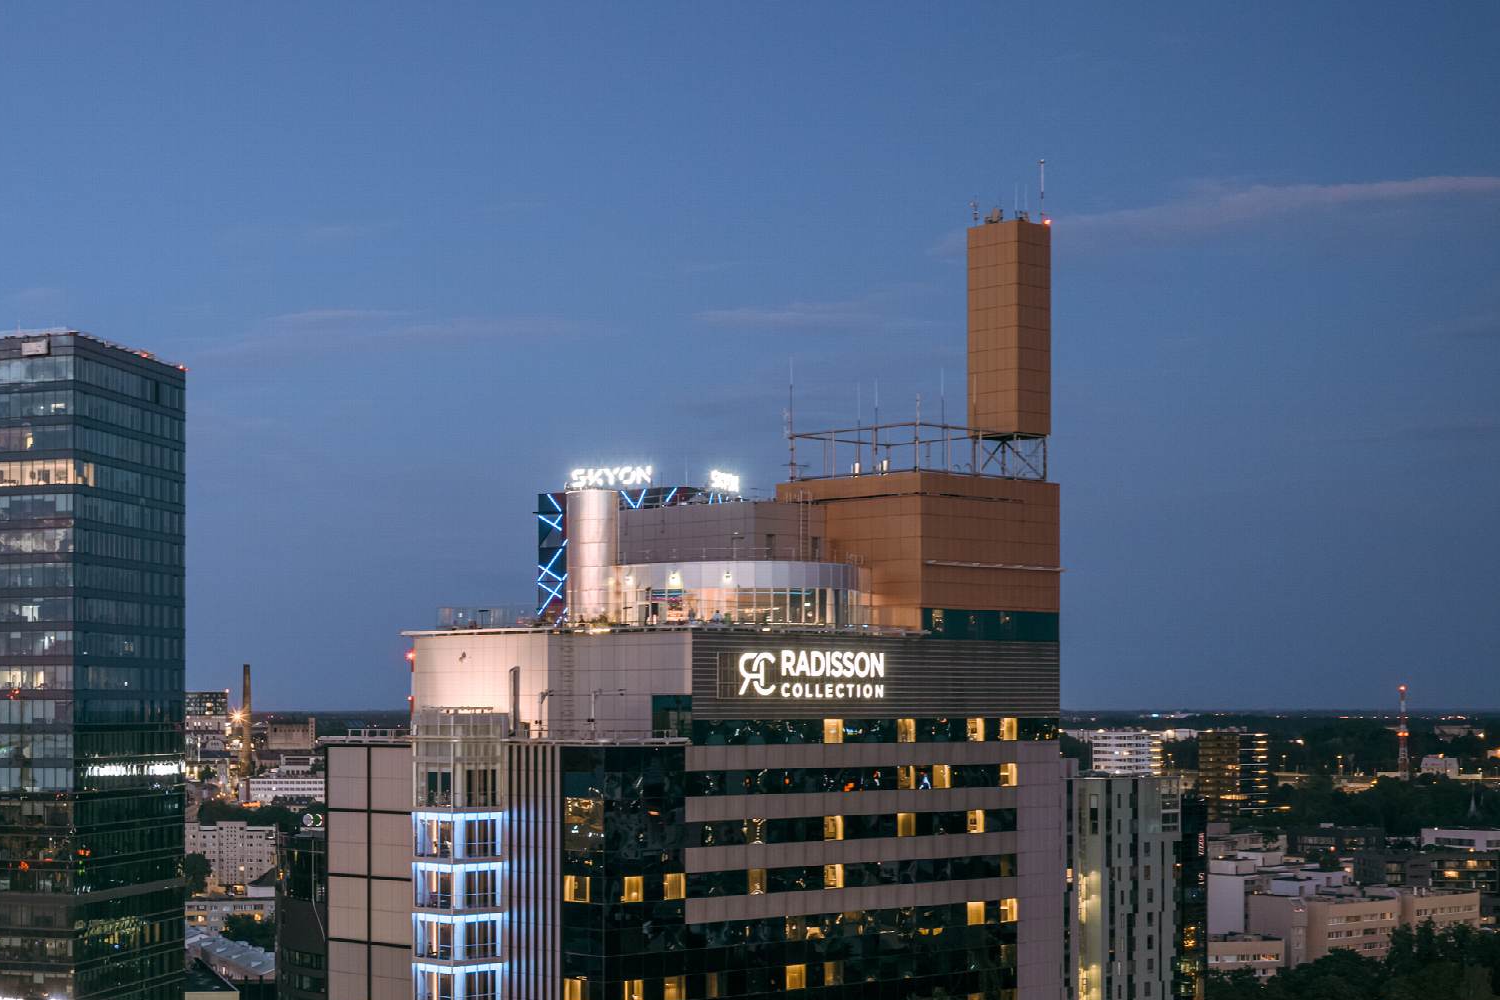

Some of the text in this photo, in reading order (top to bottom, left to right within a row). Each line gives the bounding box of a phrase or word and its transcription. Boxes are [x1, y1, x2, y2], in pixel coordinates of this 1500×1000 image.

[571, 466, 653, 488] SKYON
[780, 650, 885, 678] RADISSON
[780, 682, 885, 699] COLLECTION
